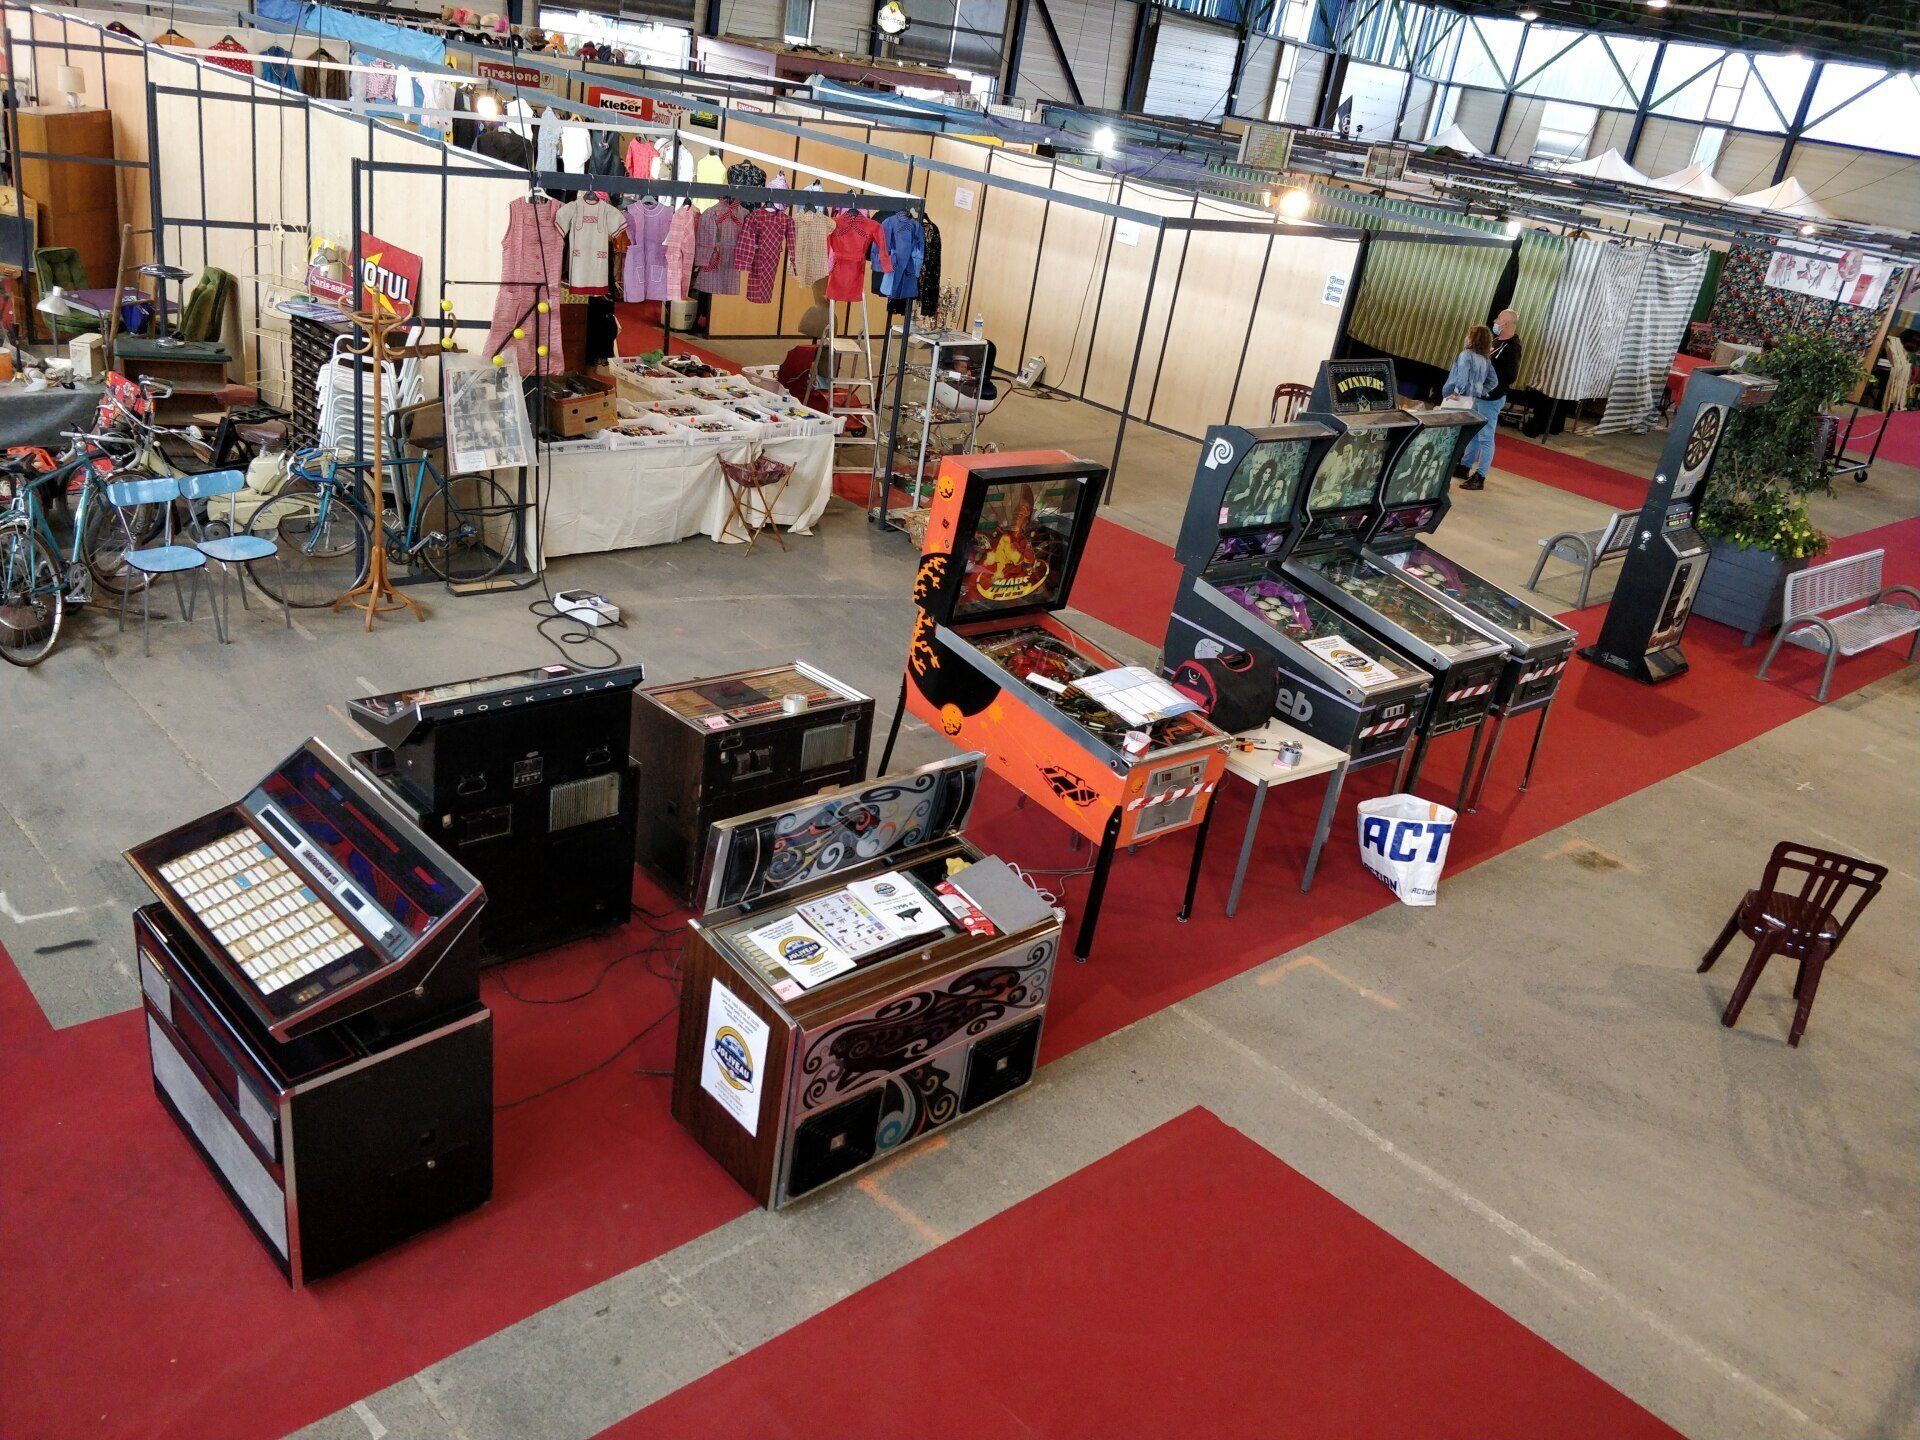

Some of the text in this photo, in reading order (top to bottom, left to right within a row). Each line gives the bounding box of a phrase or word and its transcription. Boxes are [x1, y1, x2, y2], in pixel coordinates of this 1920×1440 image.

[479, 65, 540, 83] Firestone
[600, 99, 641, 113] Kleber
[311, 275, 347, 293] Paris-soir
[1337, 375, 1385, 394] WINNER!
[1363, 816, 1453, 863] ACT
[788, 943, 820, 961] JOLIVEAU
[716, 1046, 750, 1080] JOLIVEAU
